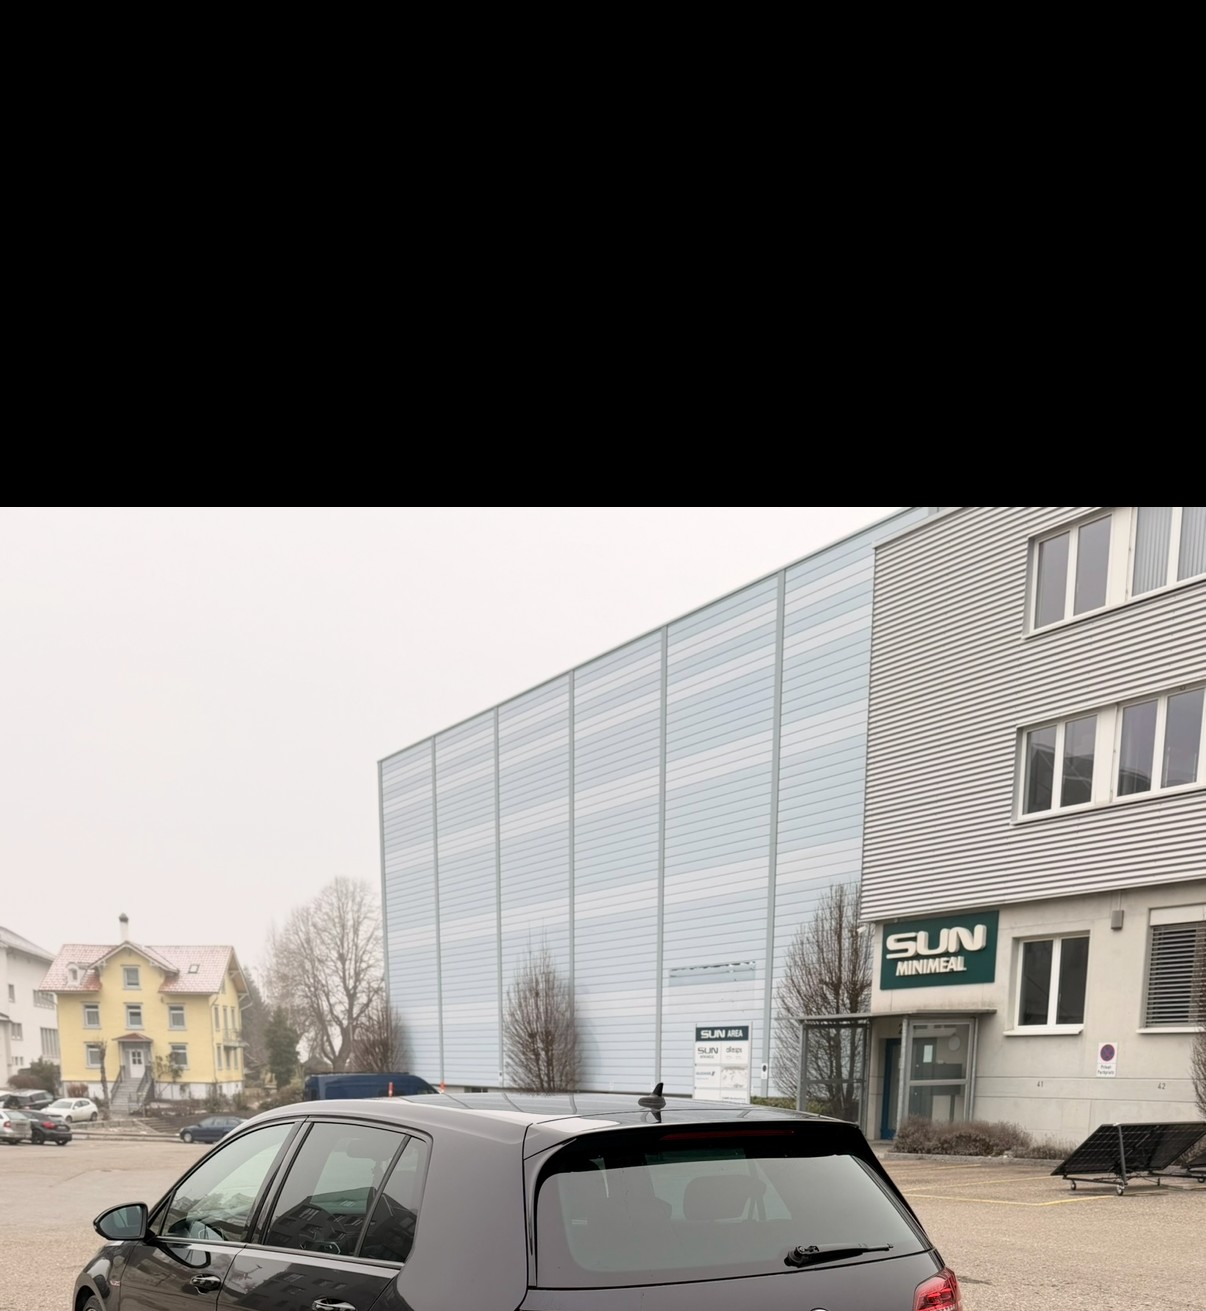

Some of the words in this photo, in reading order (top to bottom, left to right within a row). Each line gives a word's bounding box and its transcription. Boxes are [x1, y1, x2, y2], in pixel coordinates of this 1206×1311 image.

[886, 924, 987, 959] SUN
[895, 956, 967, 976] MINIMEAL
[701, 1029, 725, 1038] SUN
[727, 1029, 743, 1038] AREA
